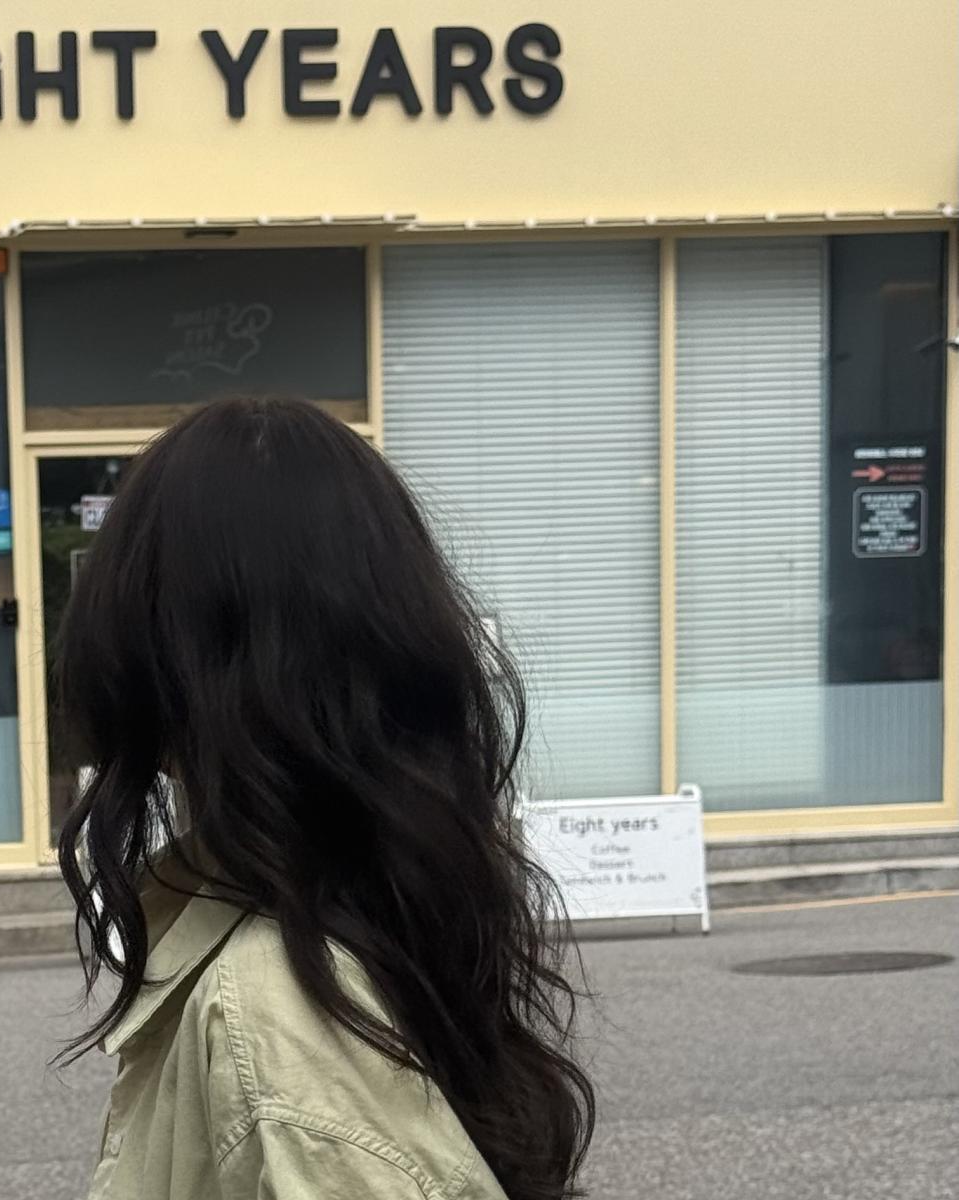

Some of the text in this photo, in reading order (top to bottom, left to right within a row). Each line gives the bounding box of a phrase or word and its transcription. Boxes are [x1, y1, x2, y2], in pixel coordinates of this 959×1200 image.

[200, 22, 564, 118] YEARS
[559, 815, 658, 838] Eight years
